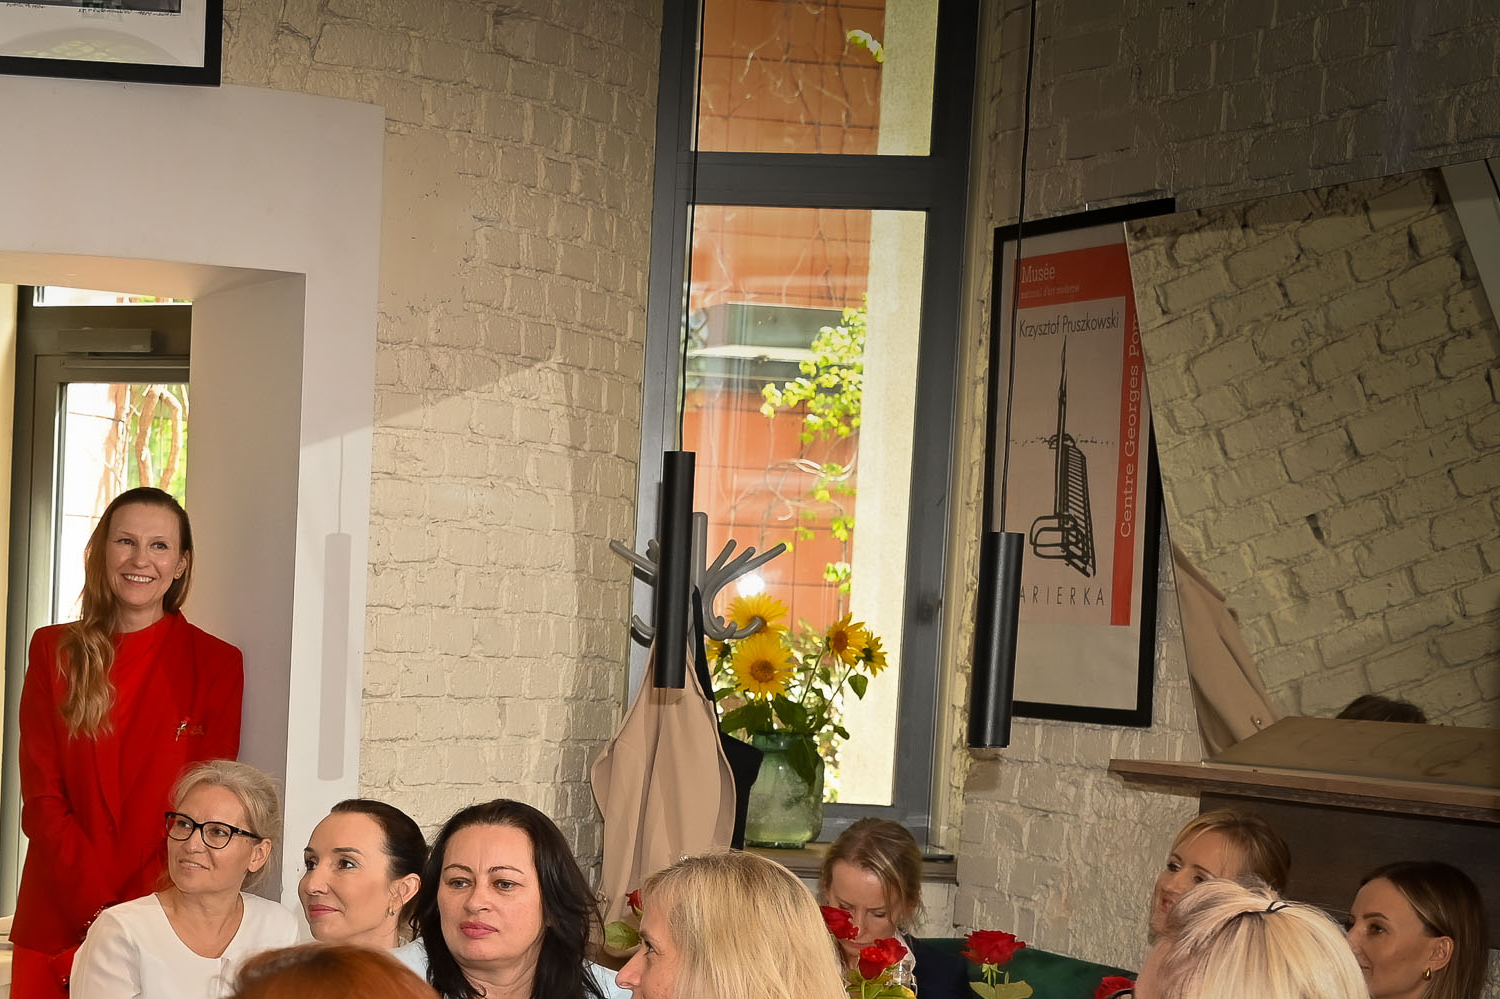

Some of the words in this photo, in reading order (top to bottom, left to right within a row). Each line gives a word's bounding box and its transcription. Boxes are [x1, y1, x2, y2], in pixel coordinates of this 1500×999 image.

[1021, 263, 1056, 283] Musée
[1019, 314, 1060, 339] Krzysztof
[1062, 310, 1119, 334] Pruszkowski
[1129, 312, 1140, 358] Pom
[1125, 365, 1141, 457] Georges
[1120, 463, 1134, 538] Centre
[1020, 585, 1104, 606] ARIERKA
